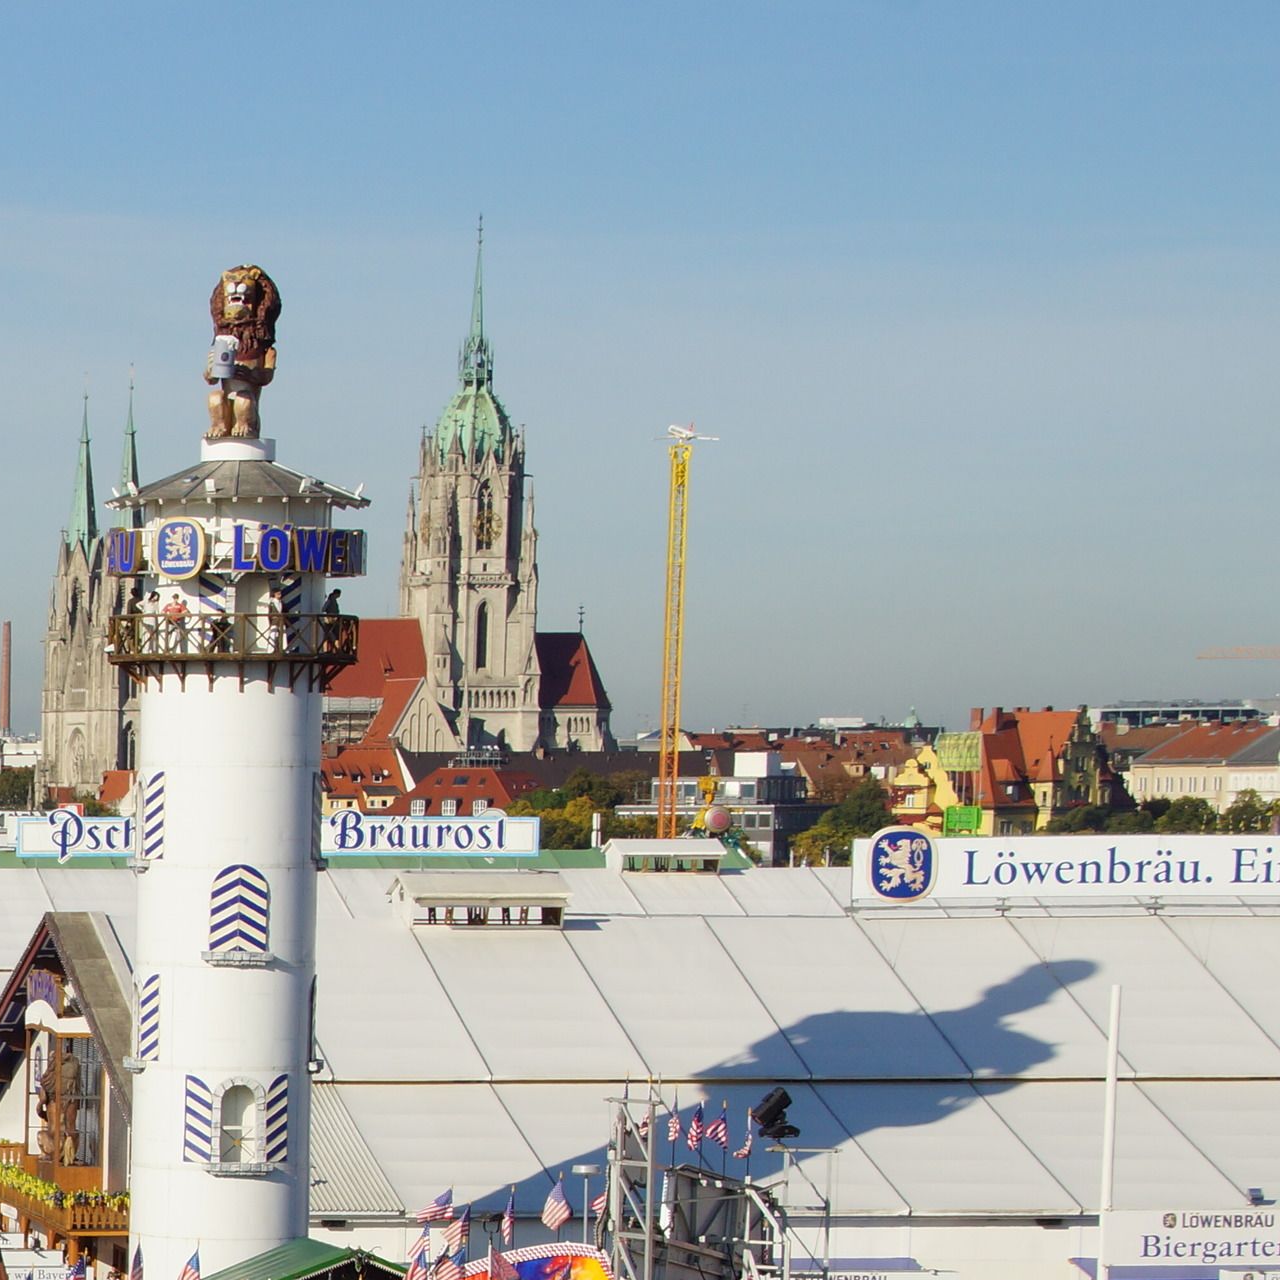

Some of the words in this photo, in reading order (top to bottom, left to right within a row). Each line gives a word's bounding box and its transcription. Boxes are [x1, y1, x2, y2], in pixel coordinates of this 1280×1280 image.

[330, 808, 507, 851] Bräurosl
[962, 846, 1214, 886] Löwenbräu.
[1182, 1211, 1275, 1228] LÖWENBRÄU
